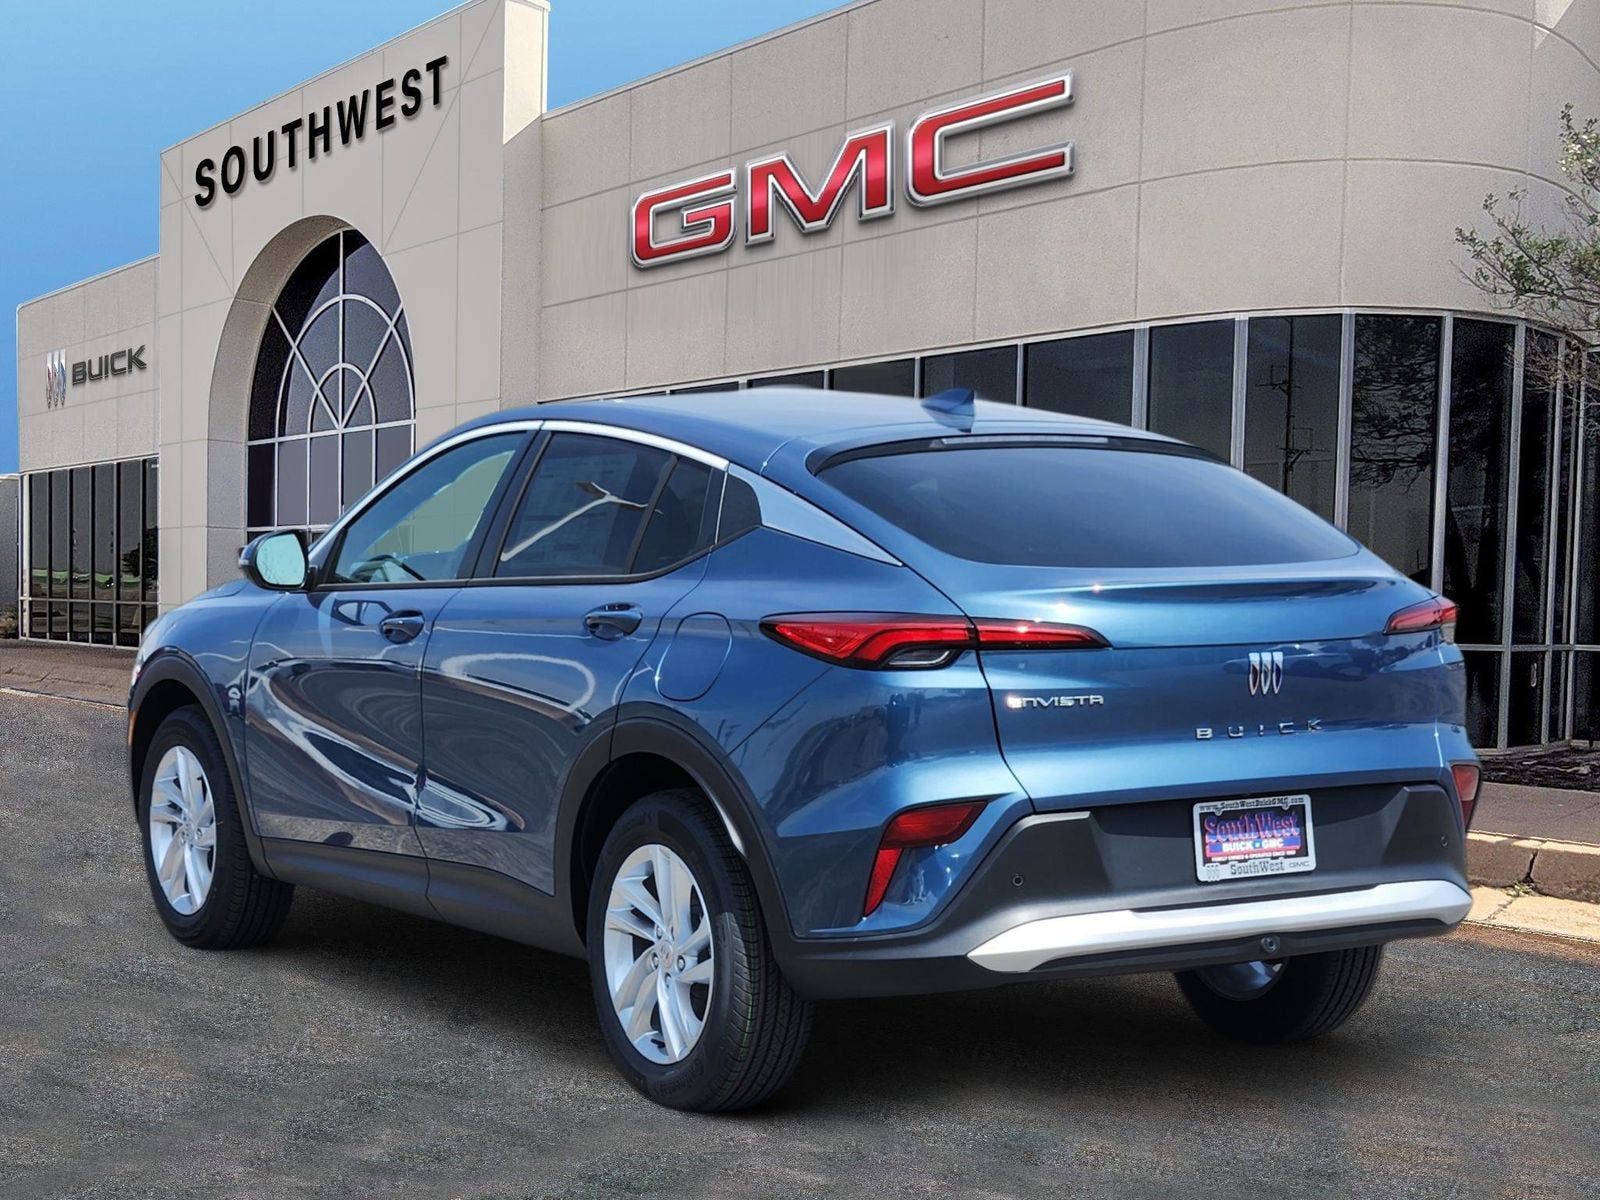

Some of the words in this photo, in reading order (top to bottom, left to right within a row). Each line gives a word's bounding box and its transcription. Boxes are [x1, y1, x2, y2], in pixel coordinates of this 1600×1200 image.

[194, 55, 448, 208] SOUTHWEST
[630, 69, 1075, 269] GMC
[72, 344, 147, 386] BUICK
[1007, 694, 1104, 709] ENVISTA
[1195, 719, 1322, 740] BUICK
[1230, 860, 1285, 875] SouthWest
